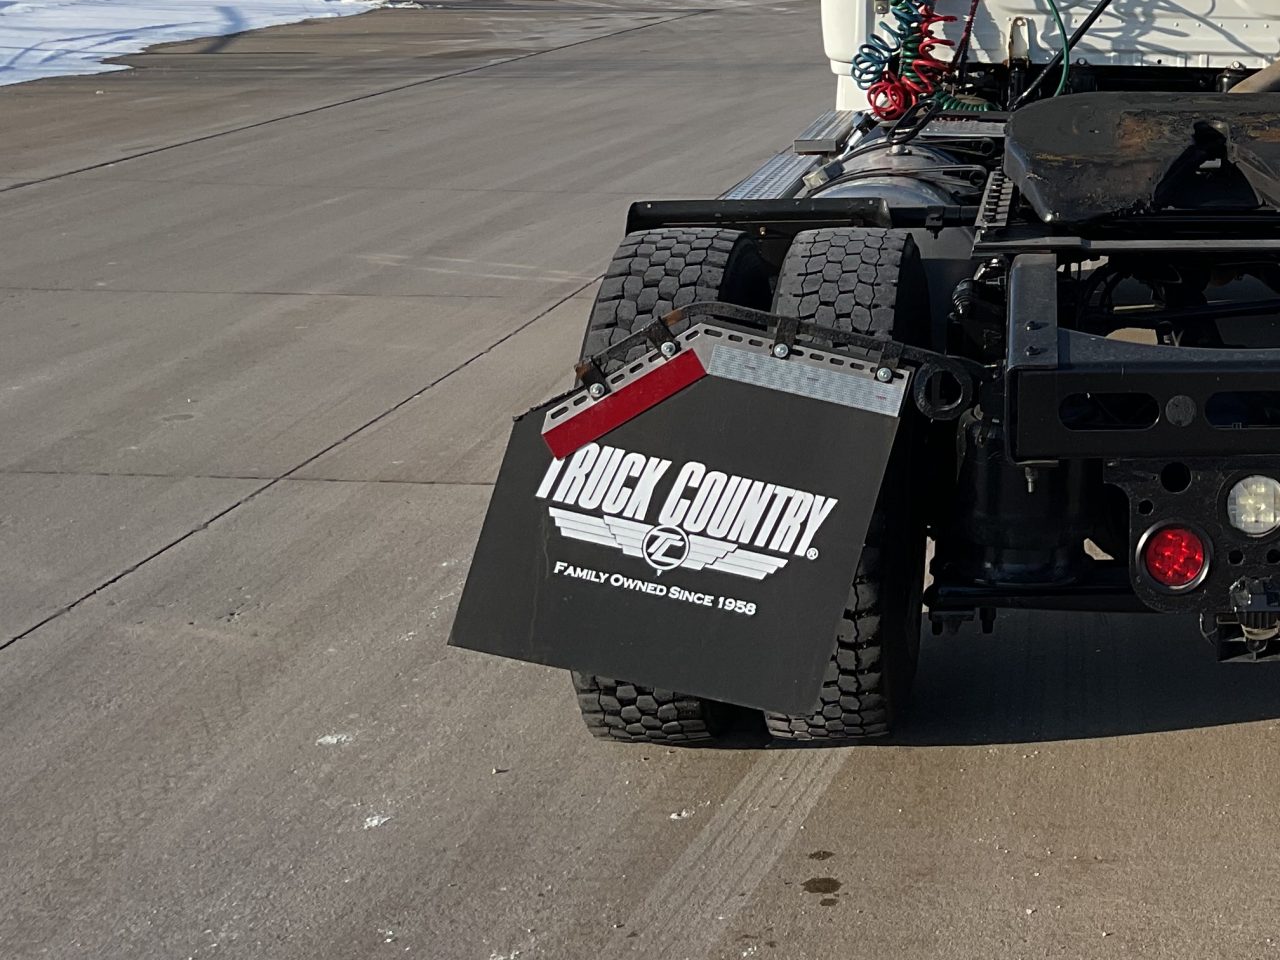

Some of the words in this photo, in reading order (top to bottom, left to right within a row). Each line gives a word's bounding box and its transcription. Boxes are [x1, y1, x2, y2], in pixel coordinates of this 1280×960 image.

[535, 442, 672, 521] TRUCK
[553, 561, 606, 584] FAMILY
[610, 573, 667, 597] OWNED
[668, 585, 714, 607] SINCE
[717, 596, 757, 616] 1958
